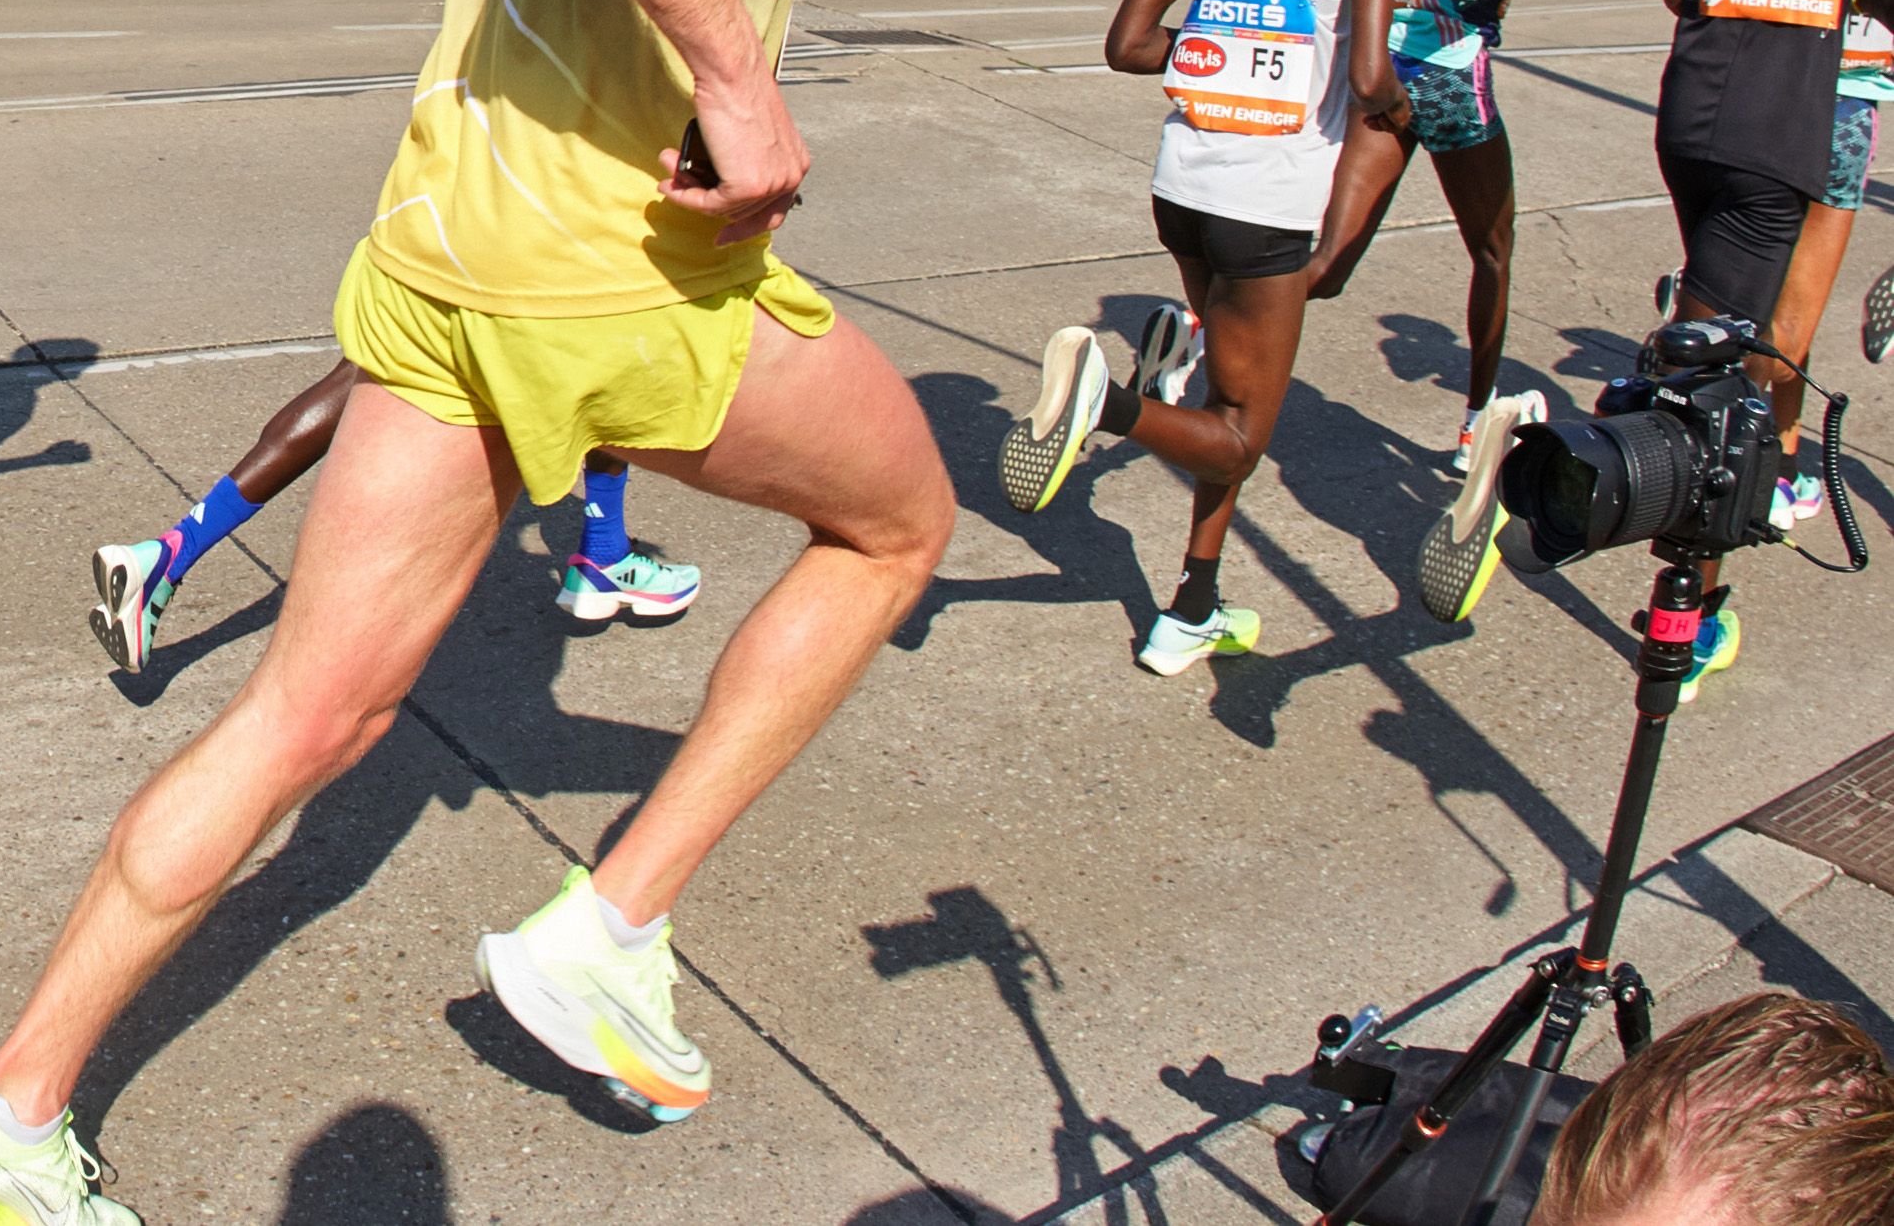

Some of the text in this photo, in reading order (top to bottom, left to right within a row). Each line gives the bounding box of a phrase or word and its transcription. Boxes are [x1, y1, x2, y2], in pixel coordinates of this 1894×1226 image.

[1198, 0, 1260, 26] ERSTE
[1174, 45, 1223, 70] Hervis
[1251, 47, 1285, 81] F5
[1193, 101, 1299, 127] WIEN ENERGIE
[1658, 386, 1687, 406] Nikon
